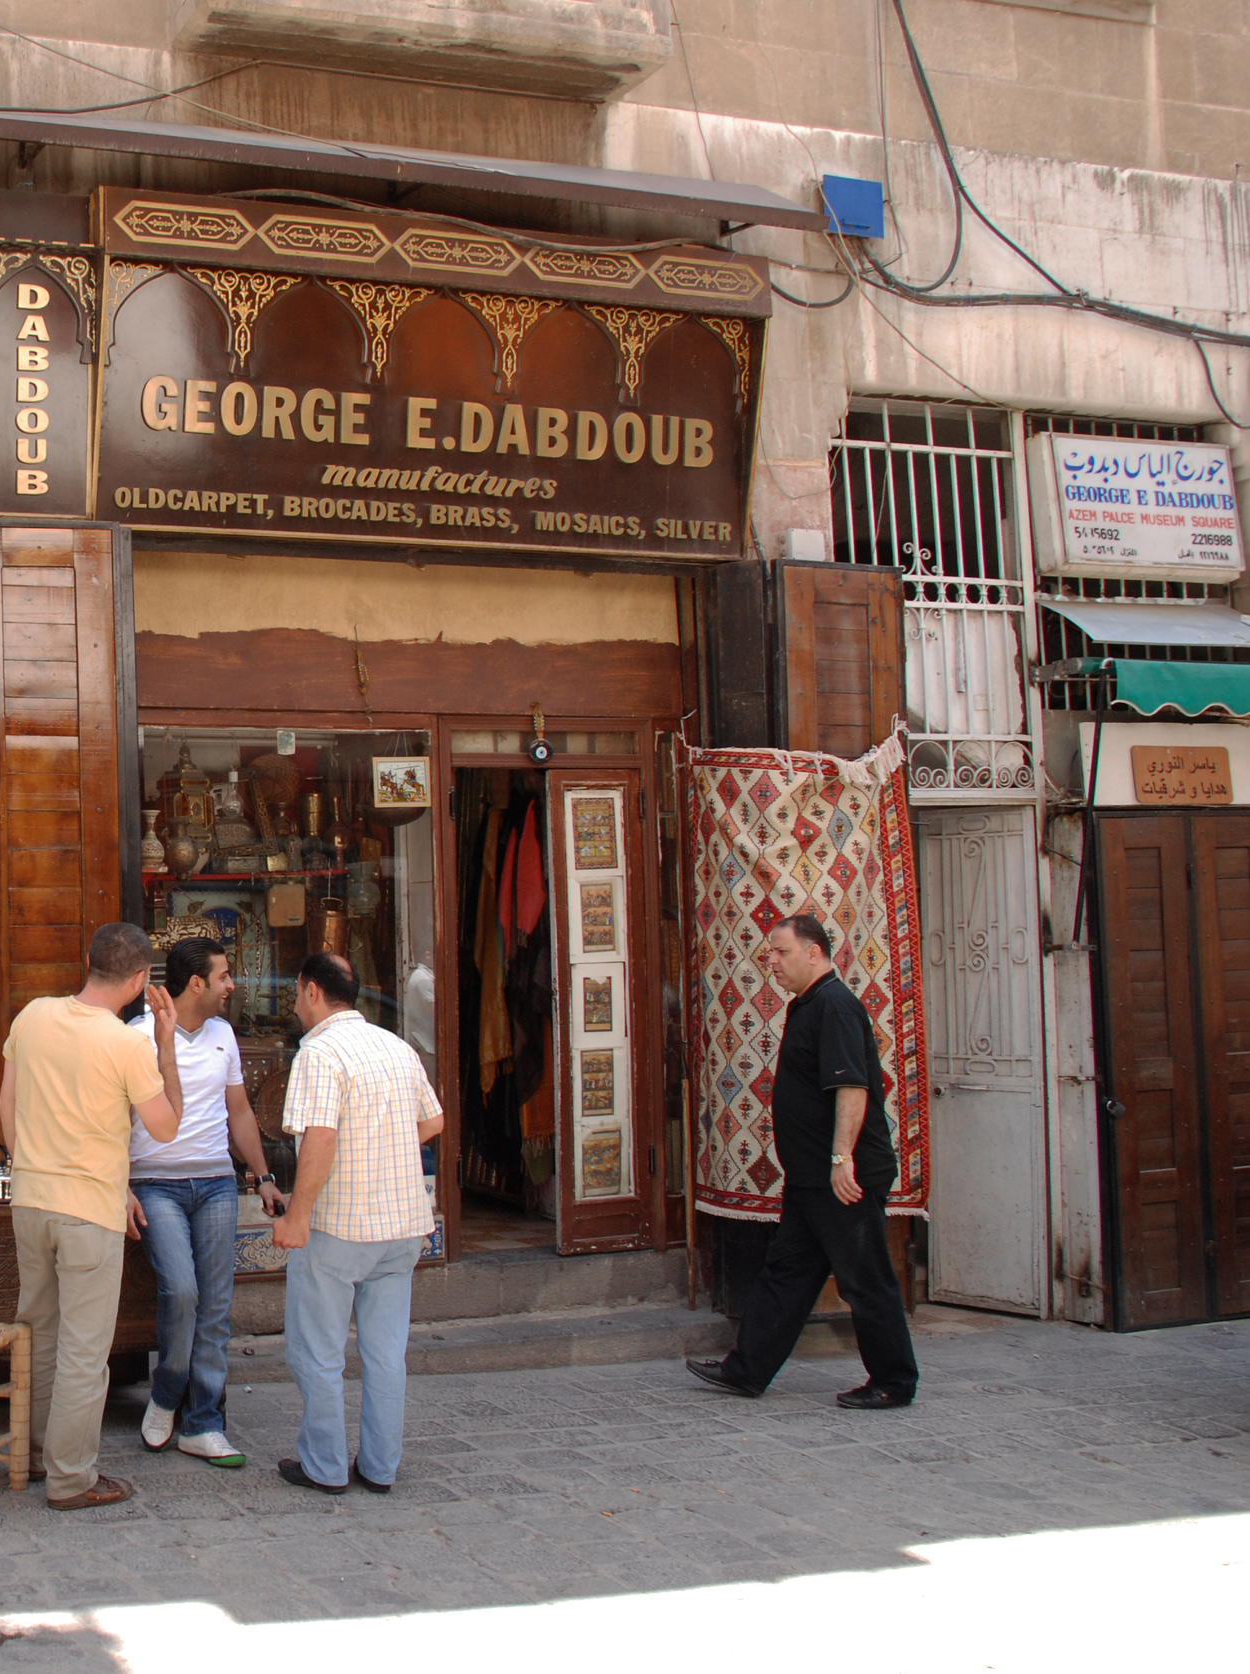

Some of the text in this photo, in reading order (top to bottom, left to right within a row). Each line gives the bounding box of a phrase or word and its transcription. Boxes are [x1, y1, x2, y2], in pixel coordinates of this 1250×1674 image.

[16, 283, 50, 495] DABDOUB
[141, 375, 371, 446] GEORGE
[321, 464, 558, 499] manufactures
[1064, 452, 1120, 483] دبدوب
[1175, 450, 1225, 485] جورج
[1065, 484, 1234, 510] GEORGE E DABDOUB
[114, 486, 732, 541] OLDCARPET, BROCADES, BRASS, MOSAICS, SILVER
[1068, 508, 1235, 529] AZEM PALCE MUSEUM SQUARE
[1191, 533, 1233, 546] 2216988
[1147, 755, 1216, 777] ياسر النوري
[1142, 778, 1227, 800] هدايا و شرقيات
